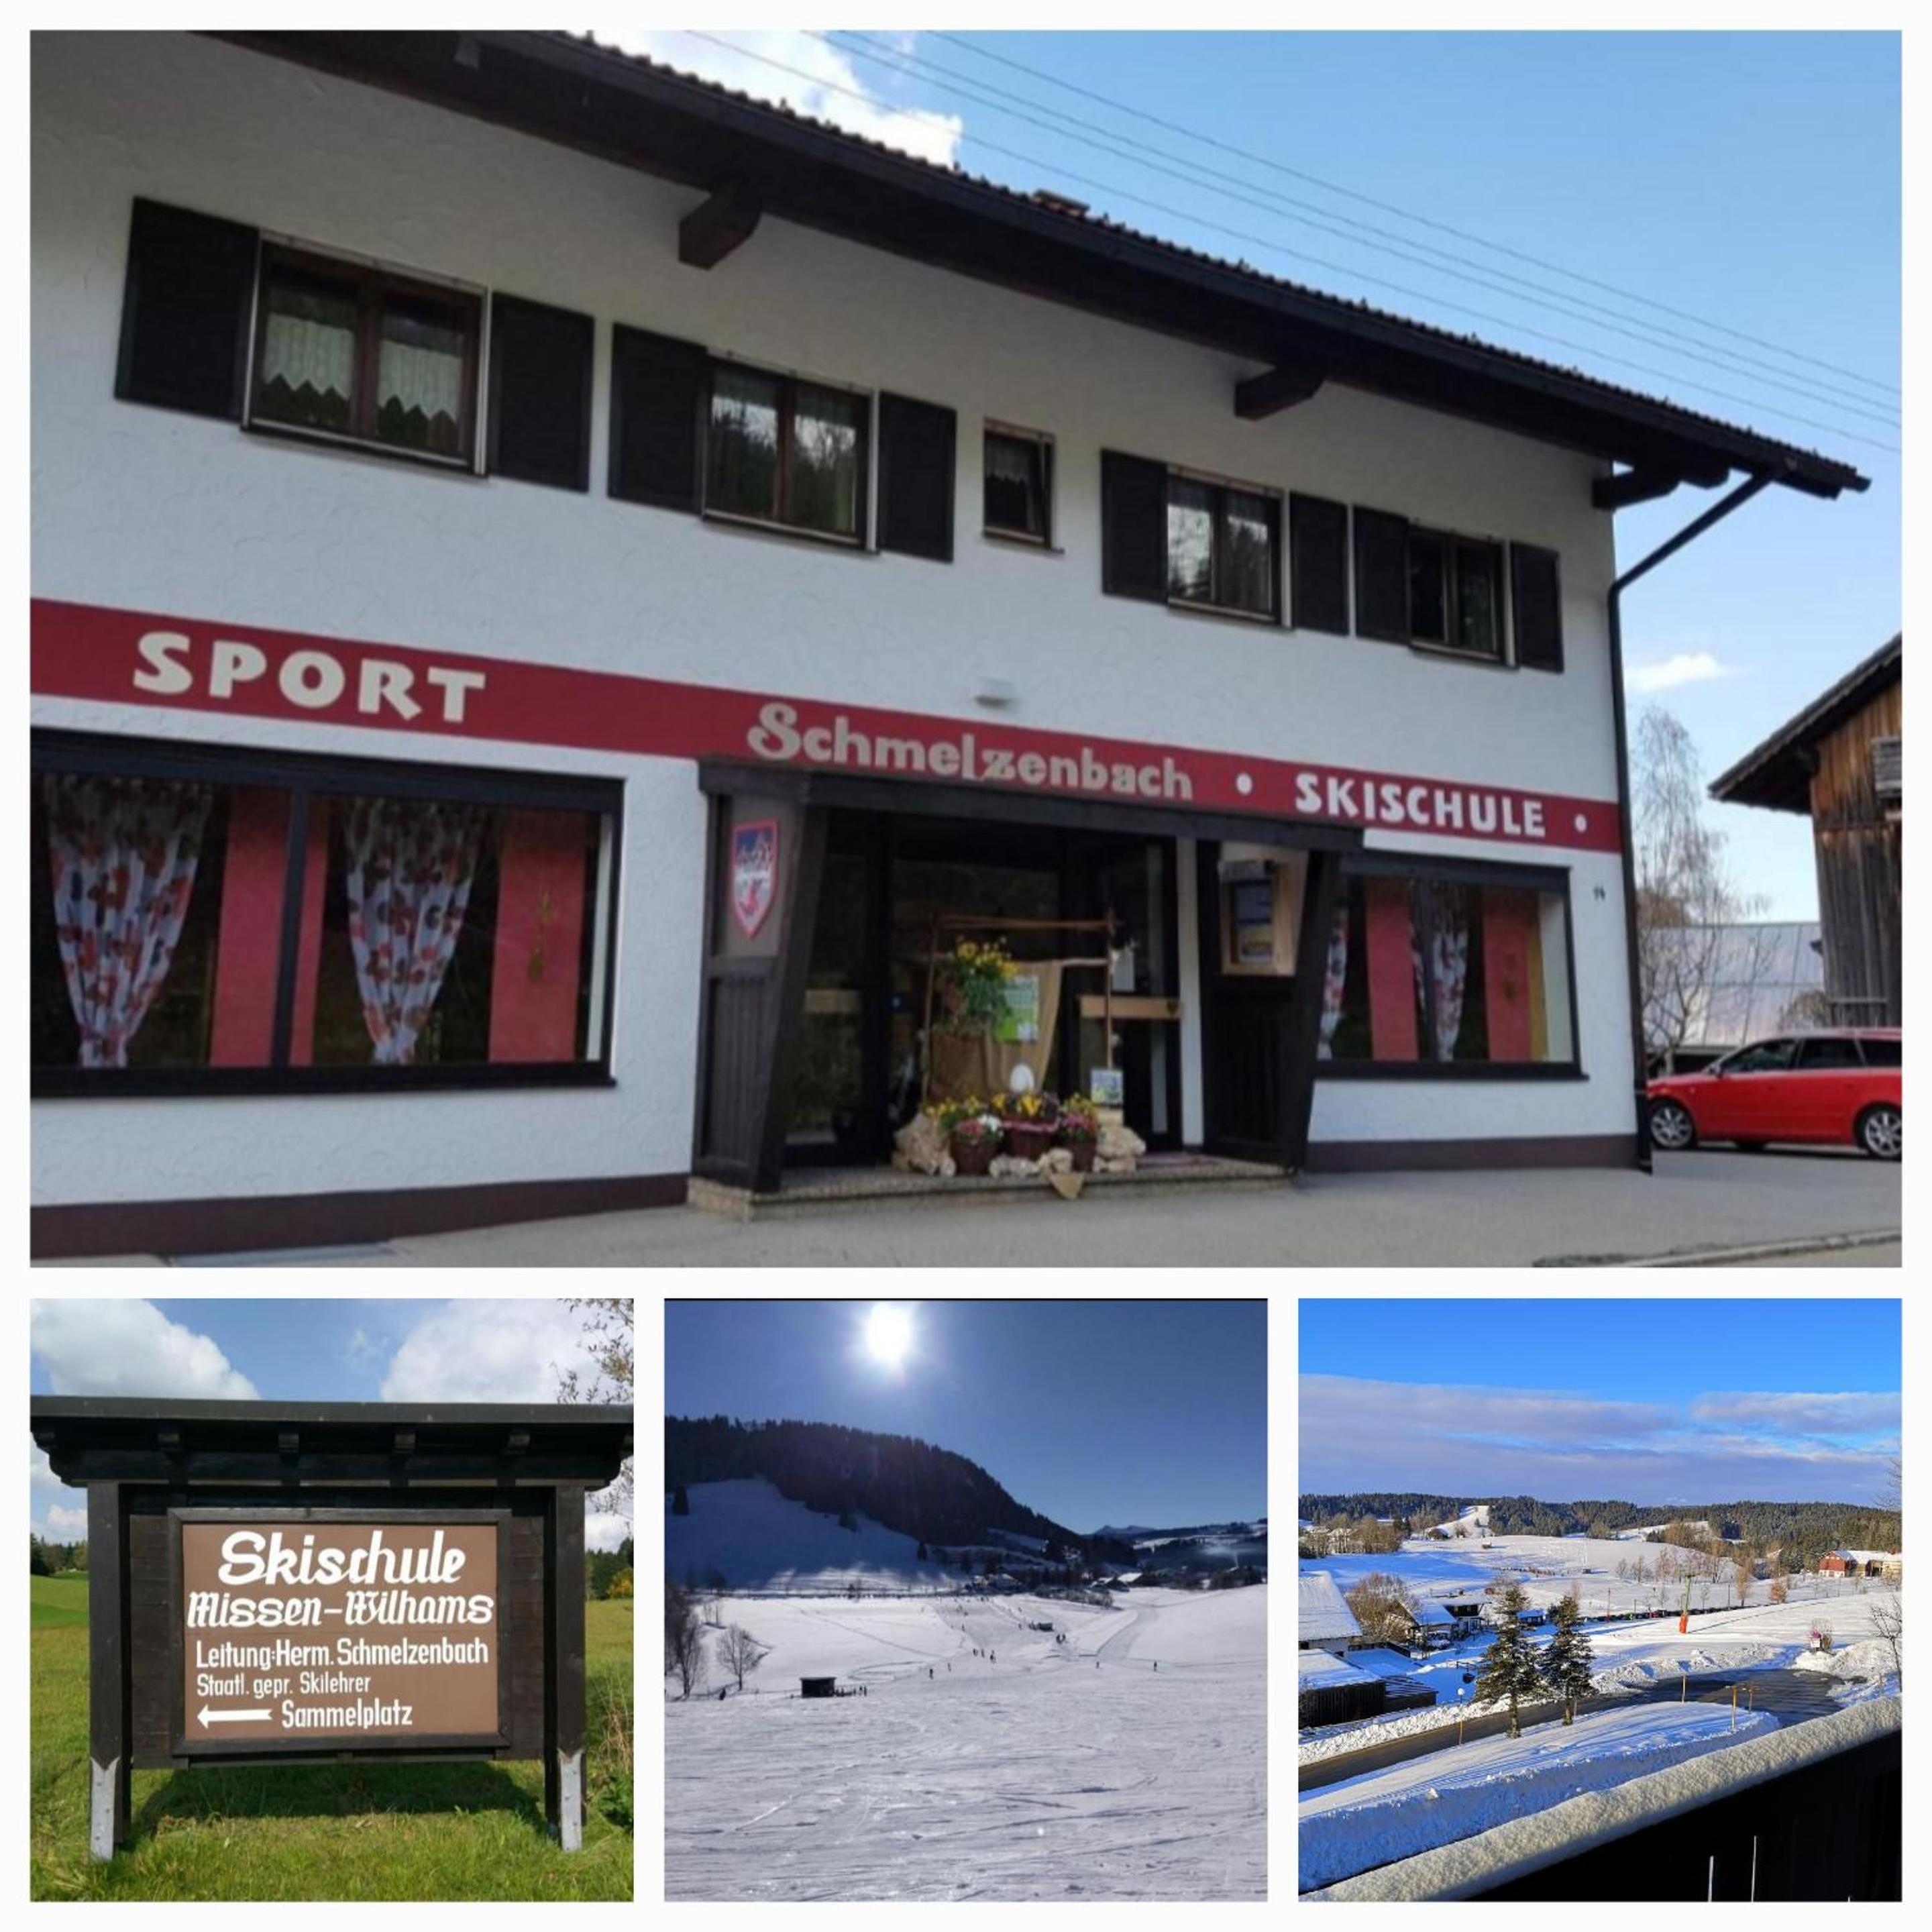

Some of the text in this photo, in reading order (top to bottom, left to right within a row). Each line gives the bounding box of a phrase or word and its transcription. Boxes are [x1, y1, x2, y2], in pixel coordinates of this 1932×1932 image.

[133, 631, 1545, 837] SPORT Schmelzenbach SKISCHULE
[218, 1529, 466, 1585] Skischule
[337, 1637, 488, 1666] Schmelzenbach
[197, 1671, 371, 1699] Staatl. gepr. Skilehrer
[282, 1698, 413, 1729] Sammelplatz
